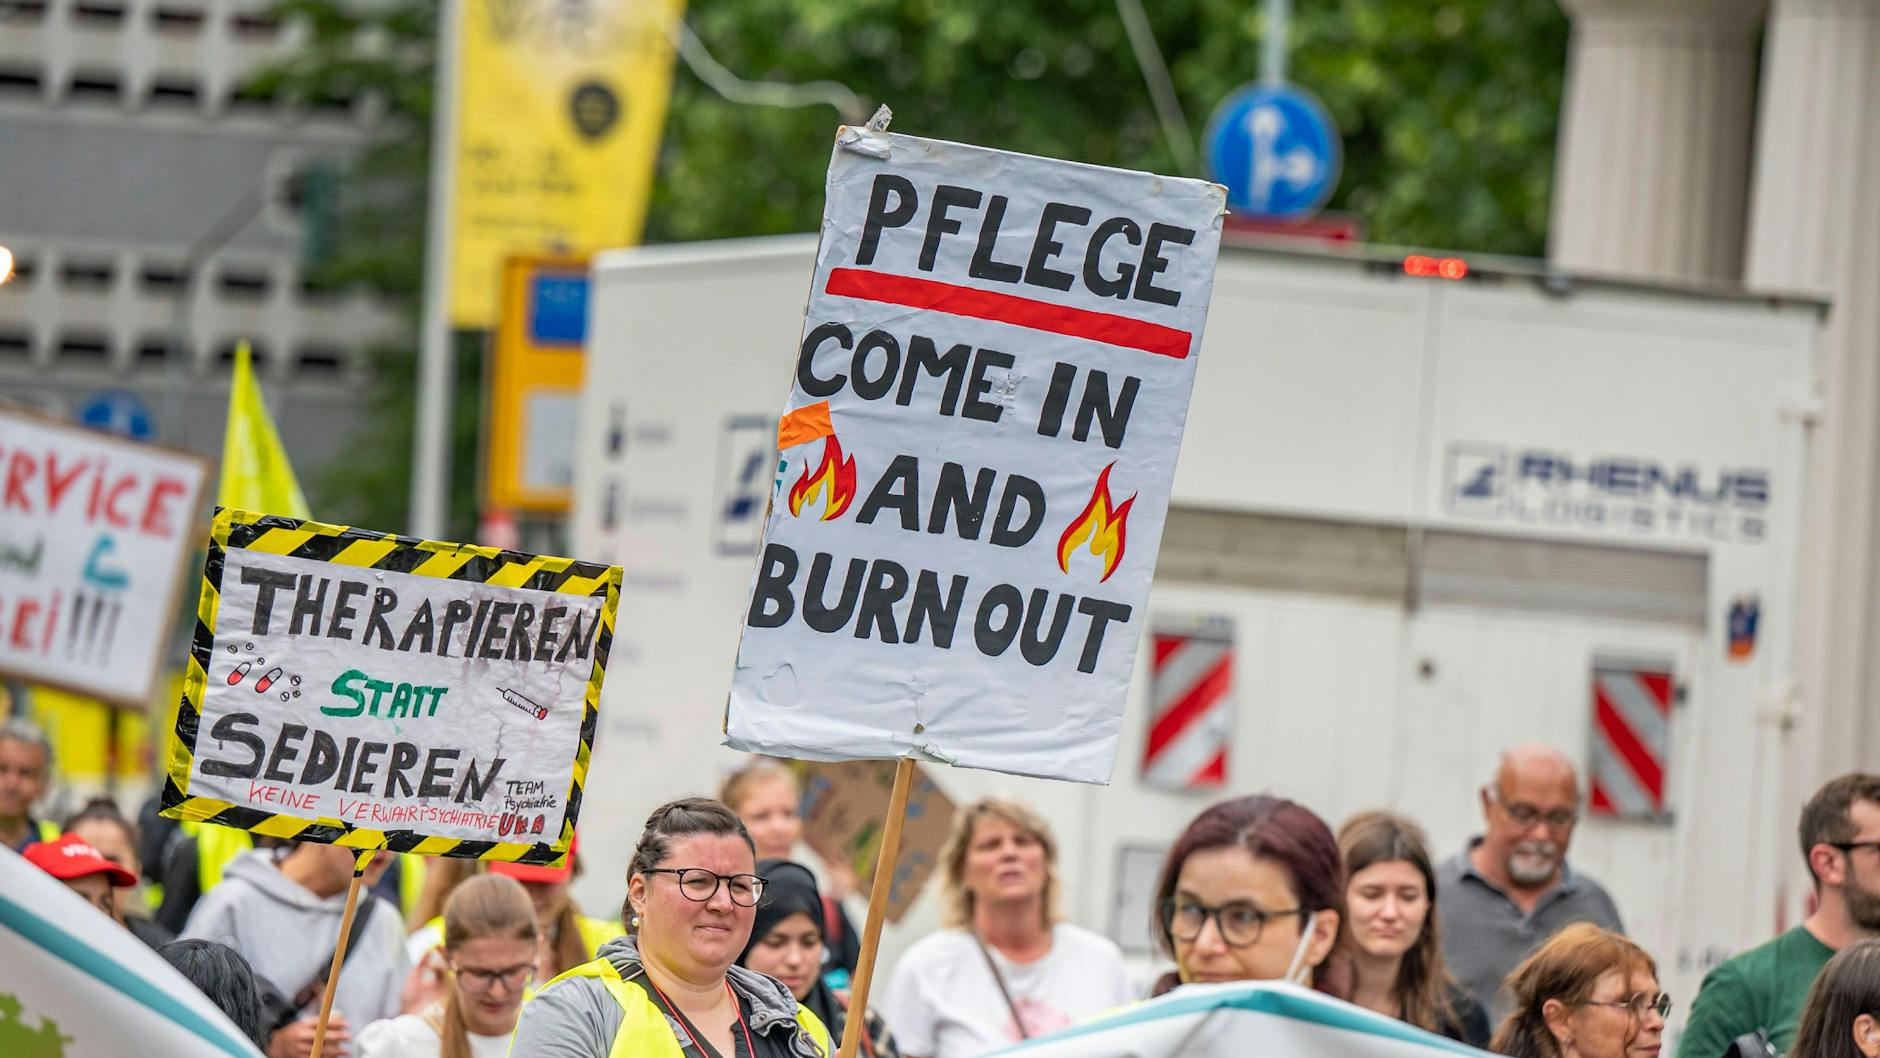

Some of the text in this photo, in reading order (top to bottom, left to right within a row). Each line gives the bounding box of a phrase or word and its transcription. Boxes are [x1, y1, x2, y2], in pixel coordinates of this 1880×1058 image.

[856, 174, 1195, 307] PFLEGE
[797, 321, 1141, 449] COME IN
[856, 455, 1046, 548] AND
[1518, 452, 1771, 508] RHENUS
[1512, 501, 1767, 541] LOGISTICS
[241, 566, 600, 662] THERAPIEREN
[320, 669, 448, 718] STATT
[200, 713, 506, 802] SEDIEREN
[249, 780, 321, 810] KEINE
[504, 794, 557, 815] Psychiatrie
[506, 781, 544, 796] TEAM
[498, 812, 546, 836] UKA
